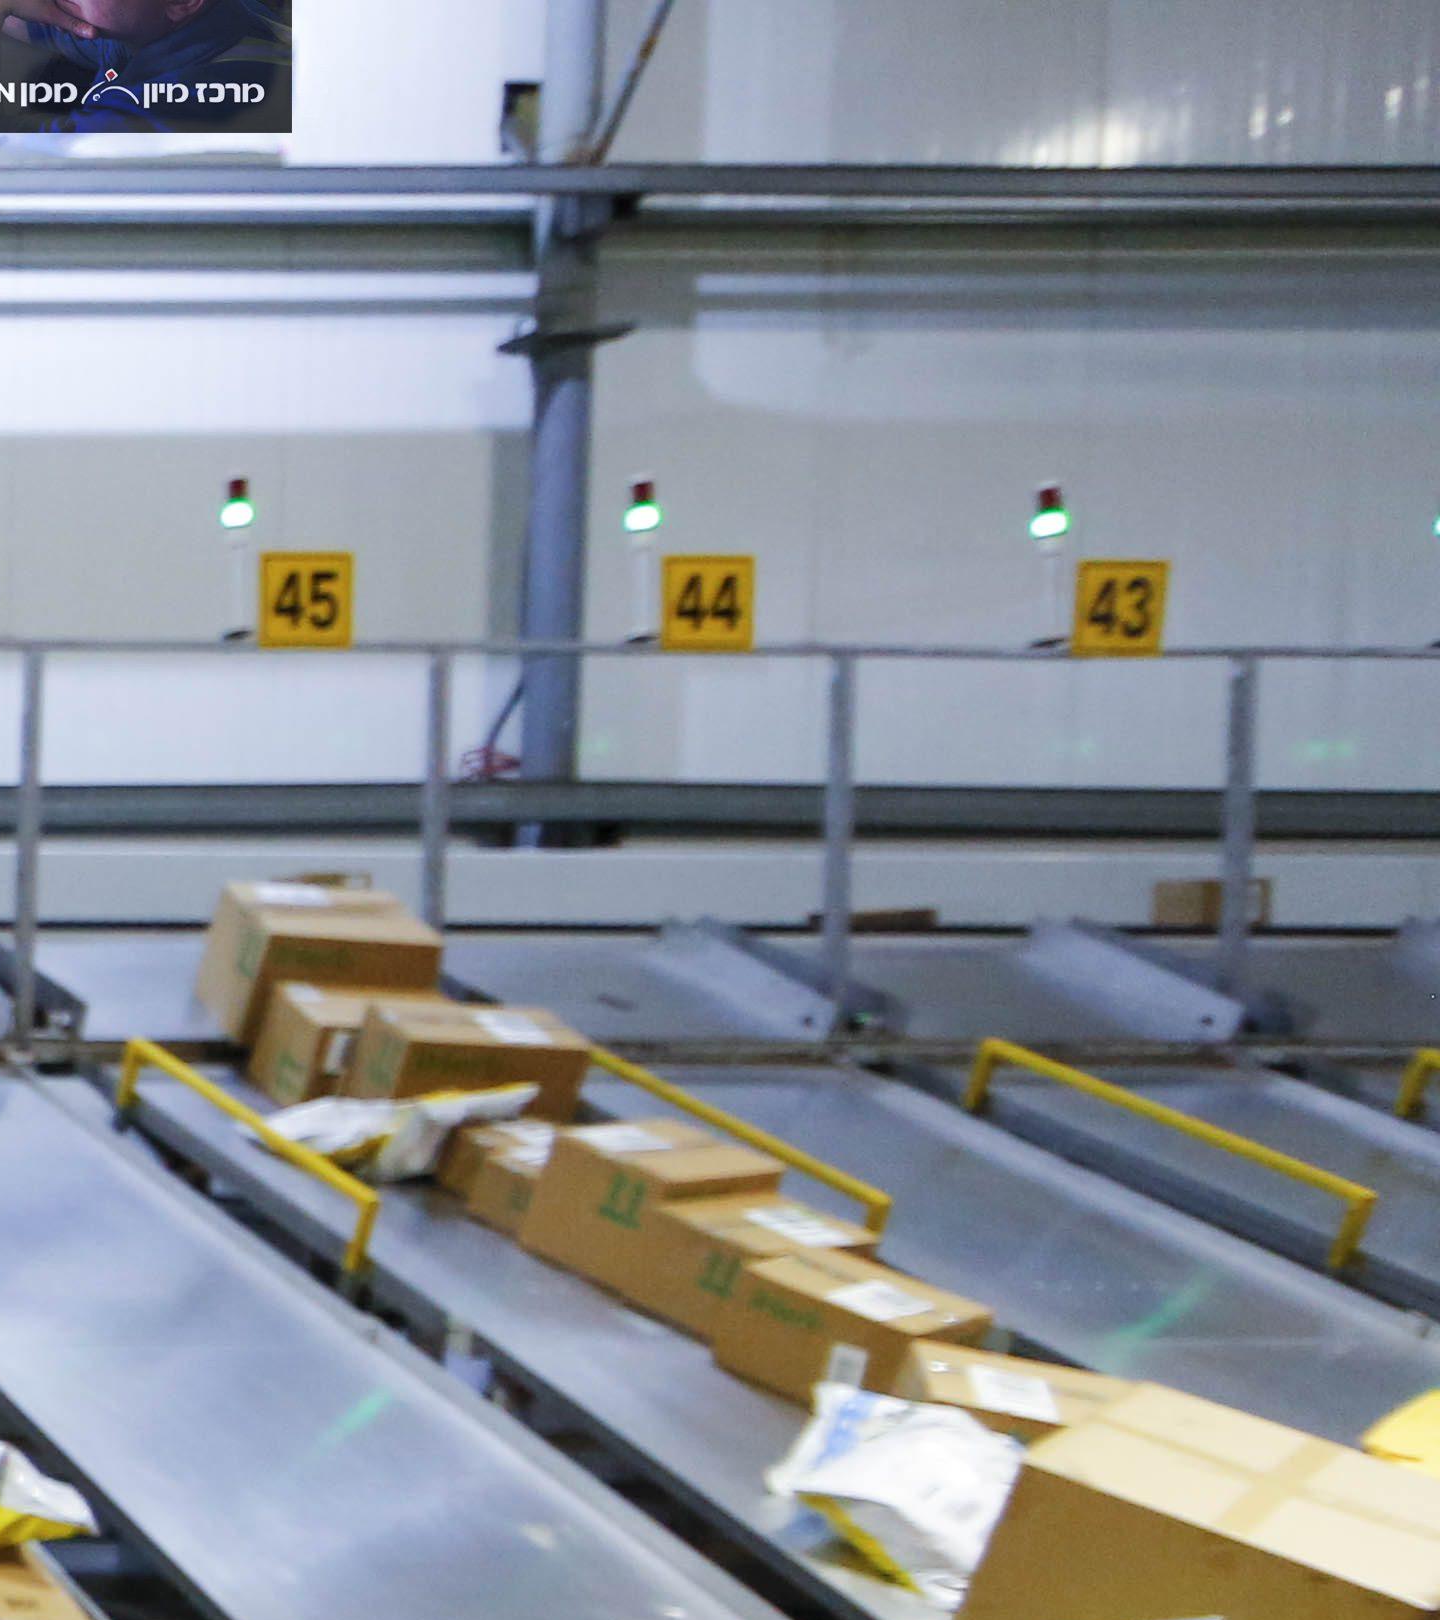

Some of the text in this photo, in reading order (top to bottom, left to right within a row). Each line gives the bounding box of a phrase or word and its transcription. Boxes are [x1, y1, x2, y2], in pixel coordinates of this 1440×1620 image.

[21, 82, 78, 107] ממן
[143, 83, 265, 109] מרכז מיון
[273, 570, 338, 630] 45
[675, 573, 741, 630] 44
[1088, 578, 1153, 638] 43
